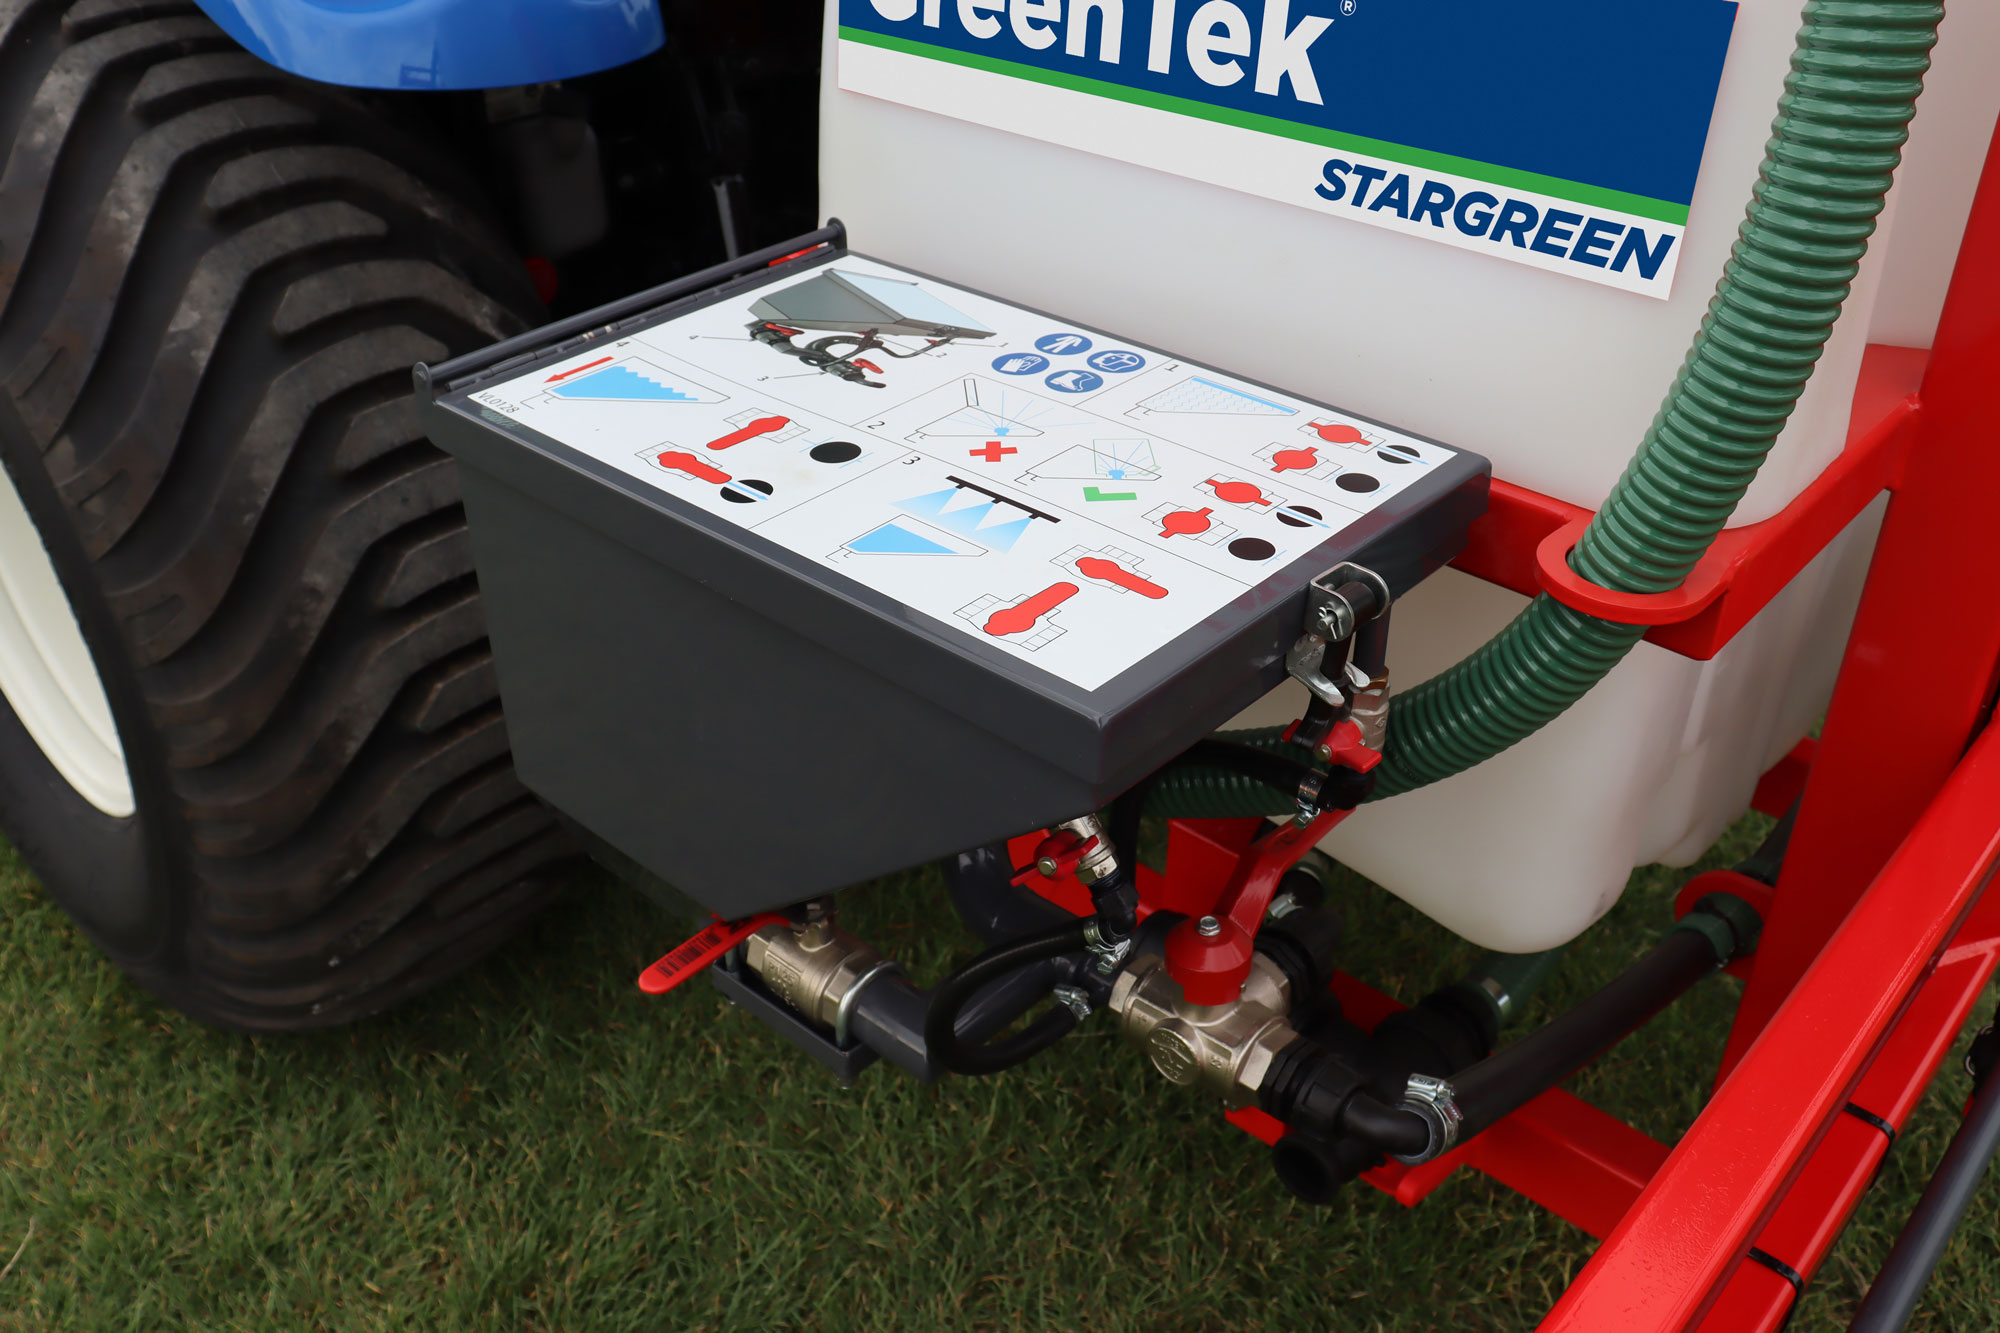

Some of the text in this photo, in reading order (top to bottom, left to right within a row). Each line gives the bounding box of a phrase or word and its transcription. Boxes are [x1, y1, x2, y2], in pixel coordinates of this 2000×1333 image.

[1314, 158, 1676, 281] STARGREEN
[1164, 363, 1179, 372] 1
[478, 392, 520, 413] VL0128
[867, 420, 885, 430] 2
[902, 455, 921, 465] 3
